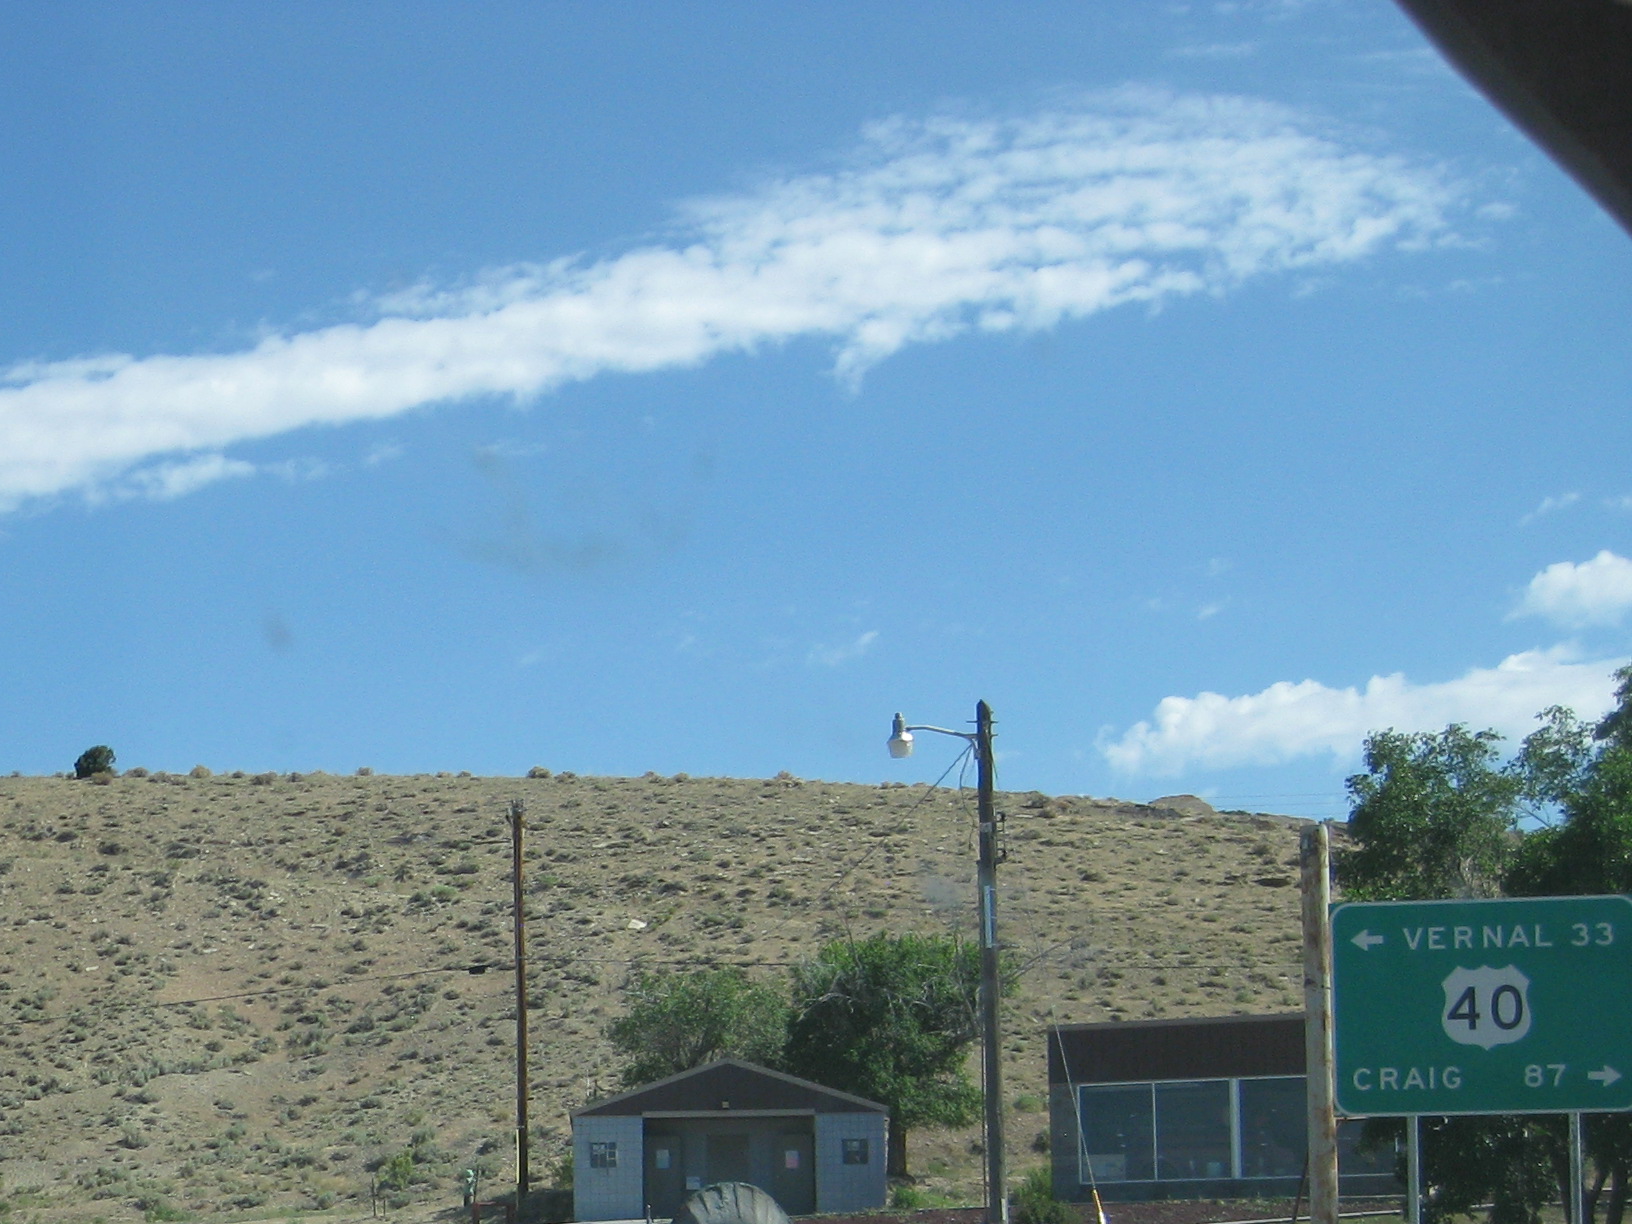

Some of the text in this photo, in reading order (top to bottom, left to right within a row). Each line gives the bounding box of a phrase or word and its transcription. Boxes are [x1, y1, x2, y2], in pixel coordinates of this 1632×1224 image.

[1402, 922, 1614, 950] VERNAL 33
[1447, 984, 1524, 1030] 40
[1352, 1064, 1566, 1091] CRAIG 87
